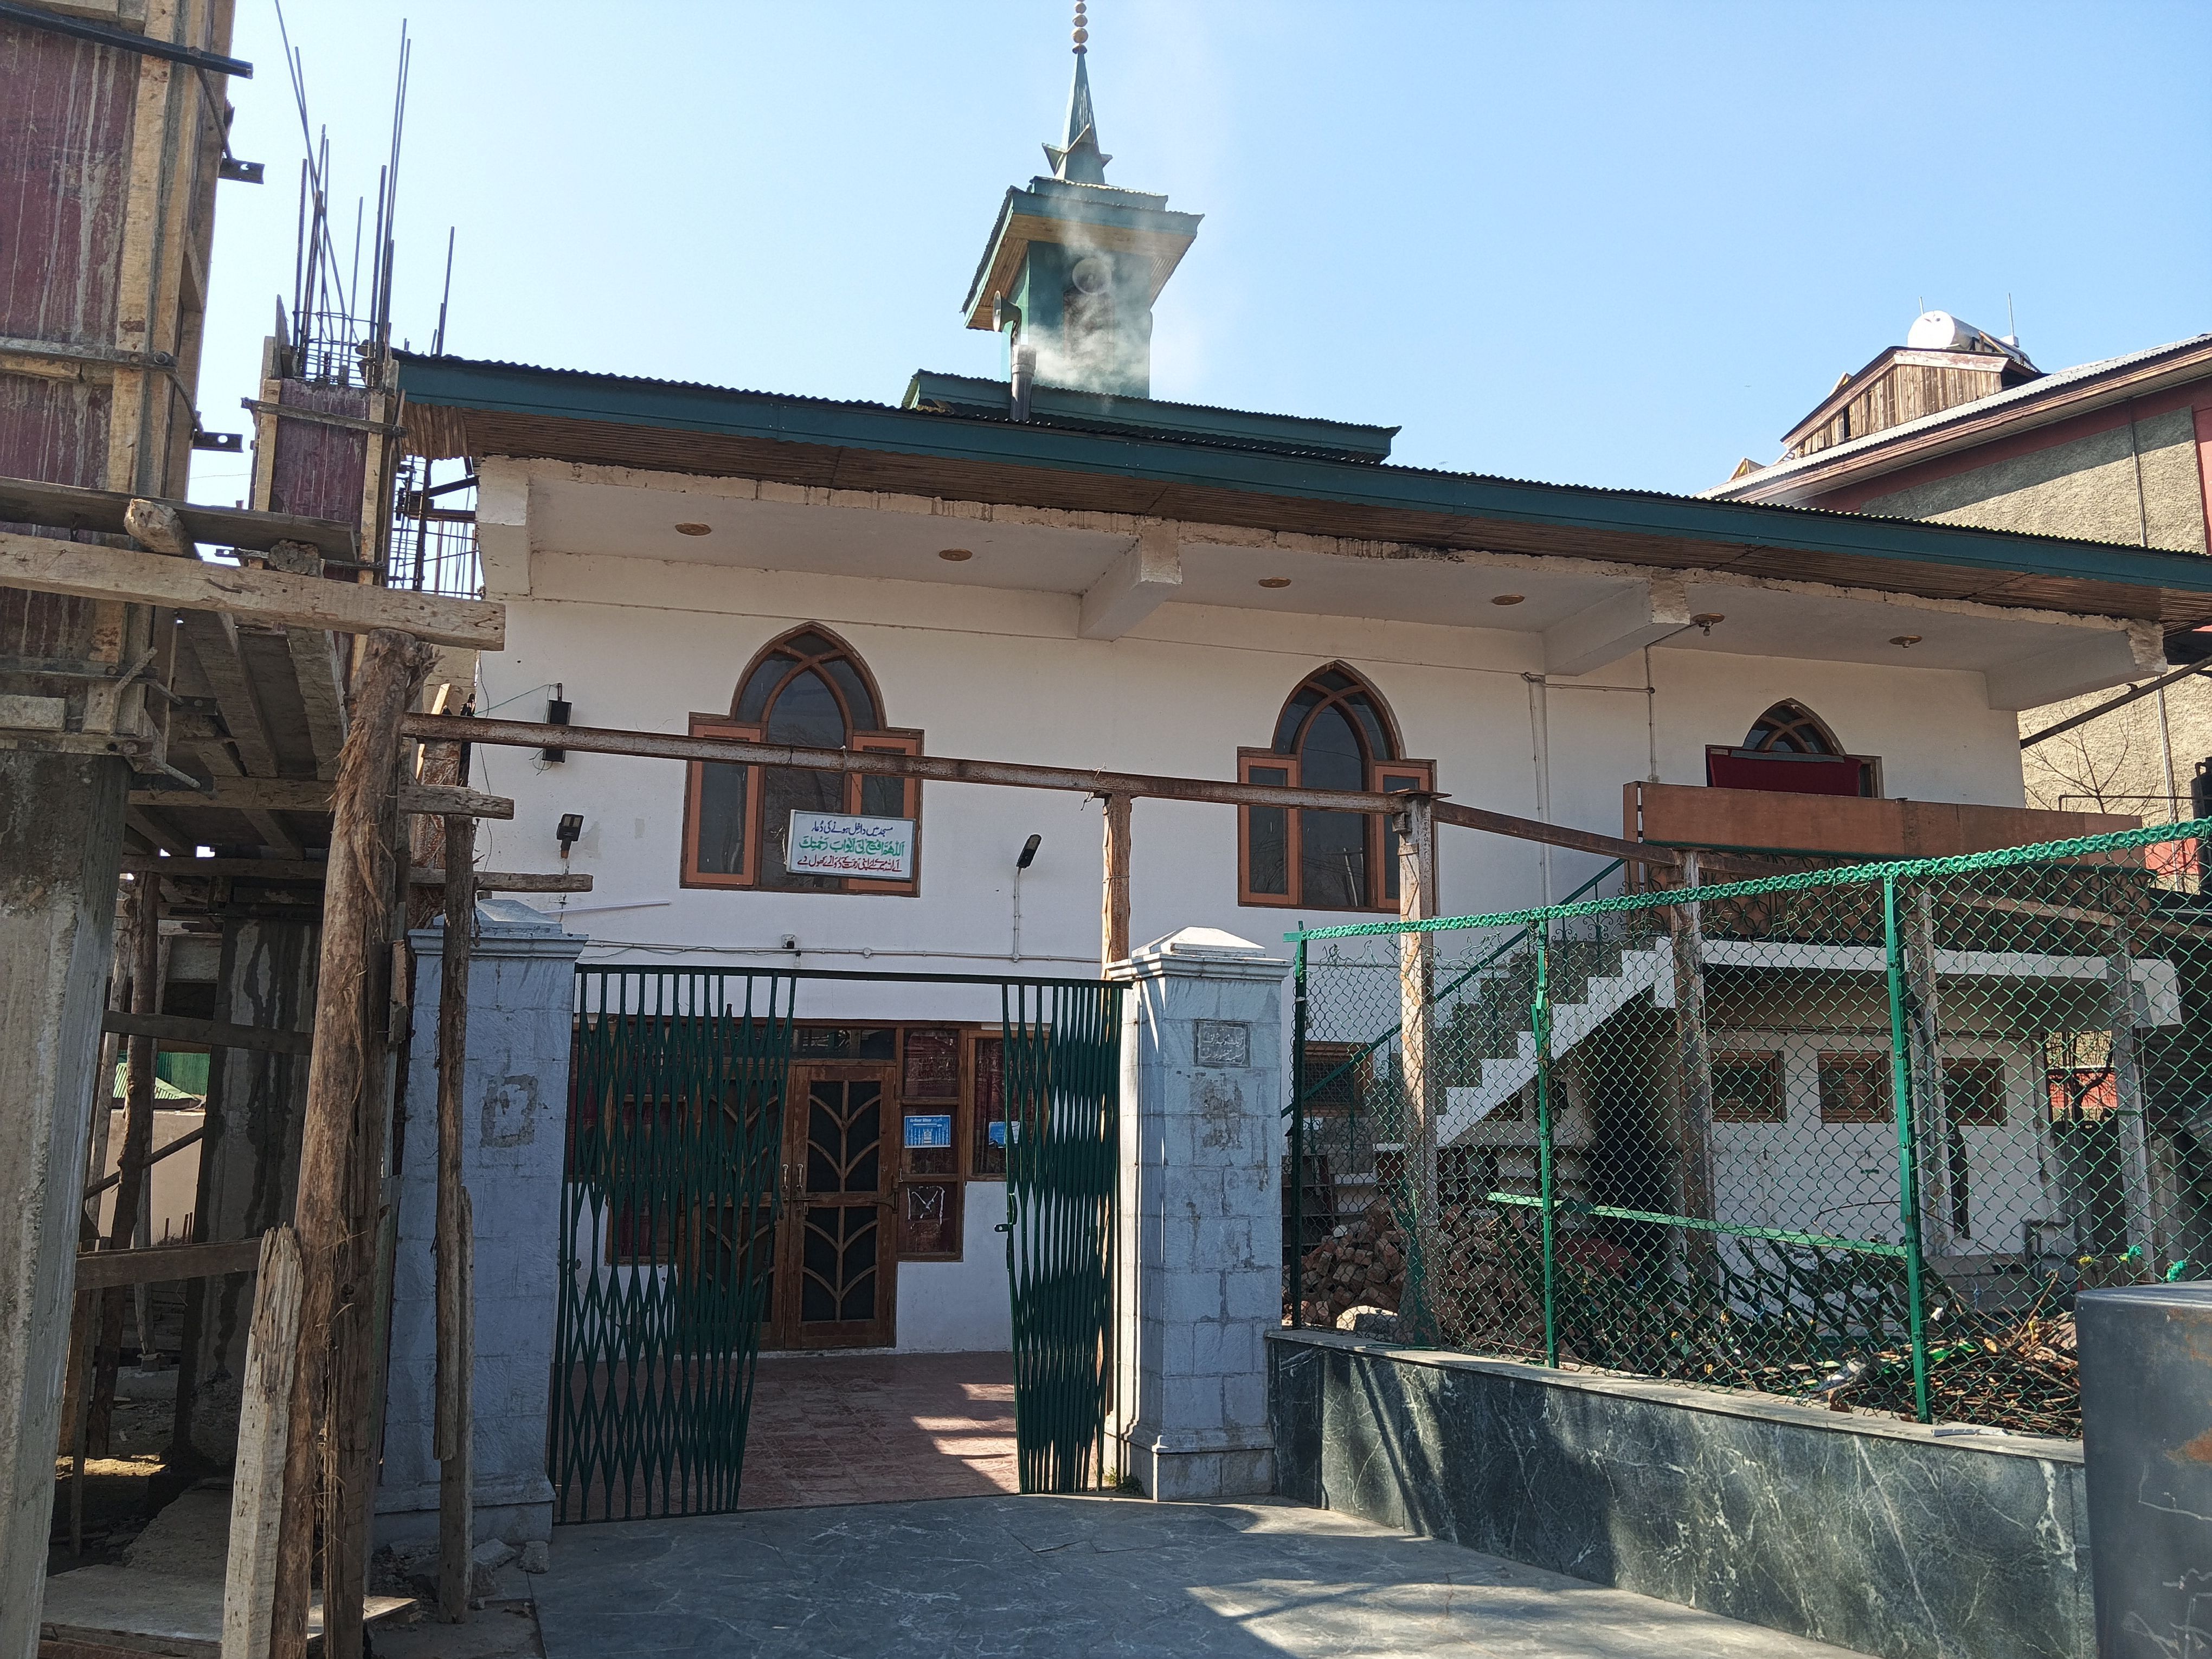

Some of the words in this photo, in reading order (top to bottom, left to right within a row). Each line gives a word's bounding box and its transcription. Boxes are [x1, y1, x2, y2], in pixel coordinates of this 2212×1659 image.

[824, 820, 832, 834] کی
[831, 821, 850, 834] ہونے
[866, 826, 879, 837] میں
[878, 826, 893, 837] مسجد
[798, 856, 808, 865] دے
[809, 854, 827, 867] کھول
[858, 858, 869, 871] اپنی
